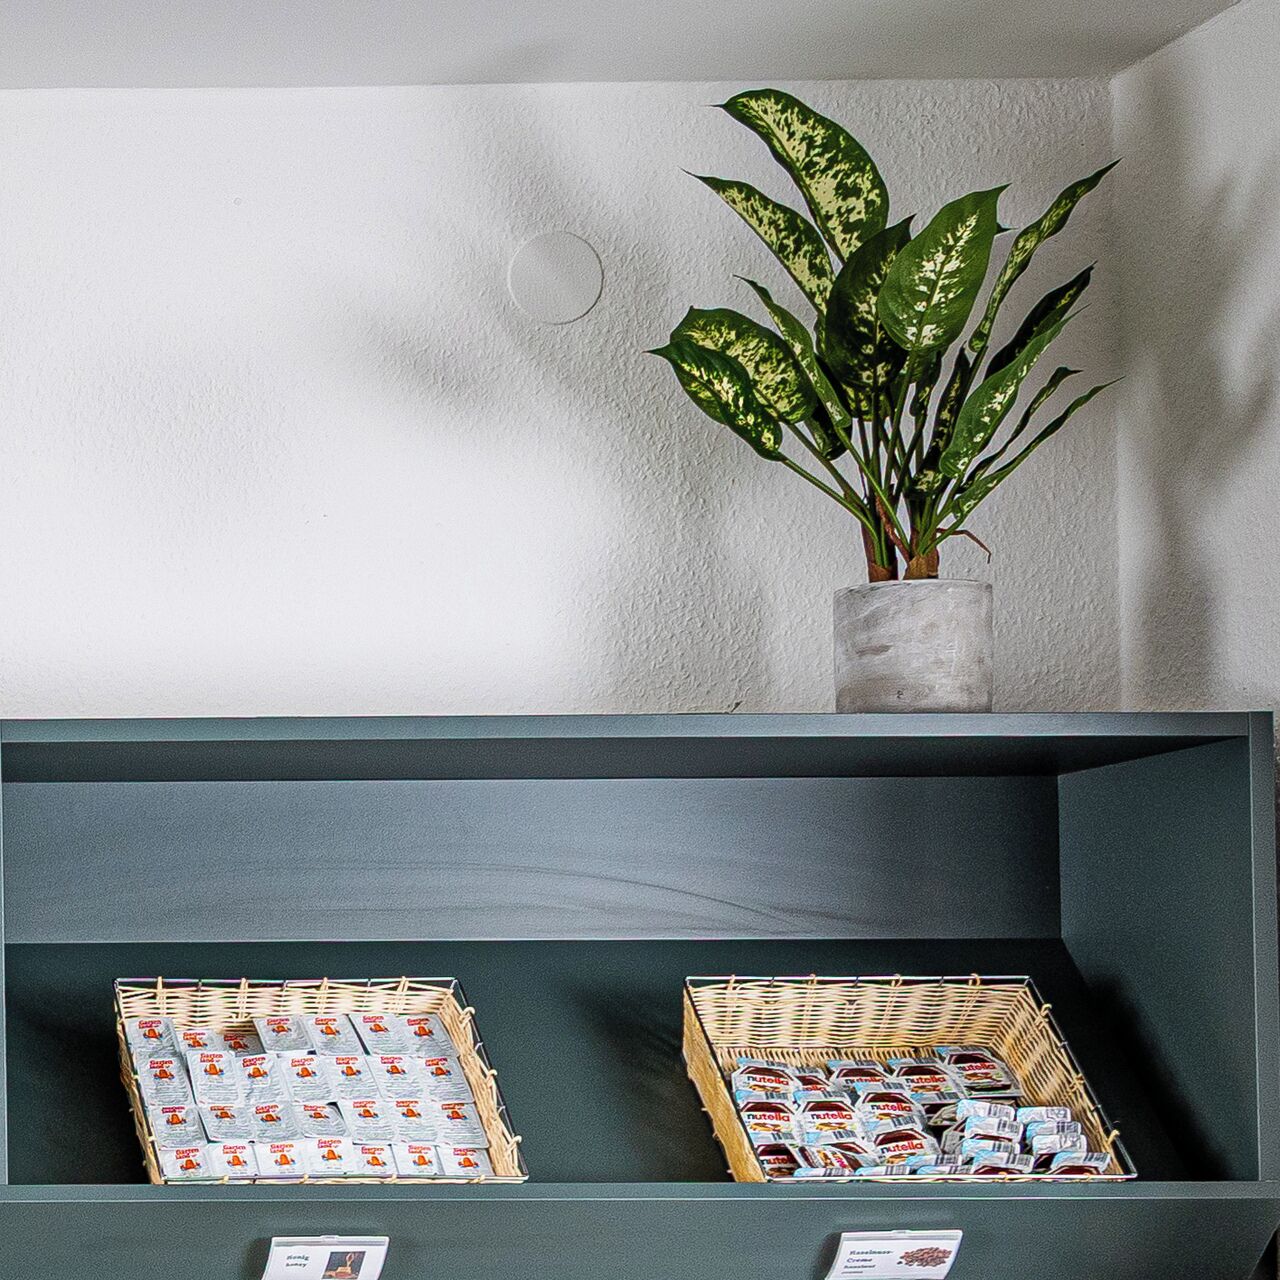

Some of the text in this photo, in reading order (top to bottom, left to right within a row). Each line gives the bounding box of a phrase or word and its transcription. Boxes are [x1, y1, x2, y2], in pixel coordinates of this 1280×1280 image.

[957, 1062, 997, 1071] nutella
[747, 1075, 789, 1086] nutella
[906, 1075, 946, 1084] nutella
[871, 1103, 913, 1112] nutella
[747, 1113, 790, 1122] nutella
[811, 1112, 853, 1120] nutella
[880, 1140, 925, 1155] nutella
